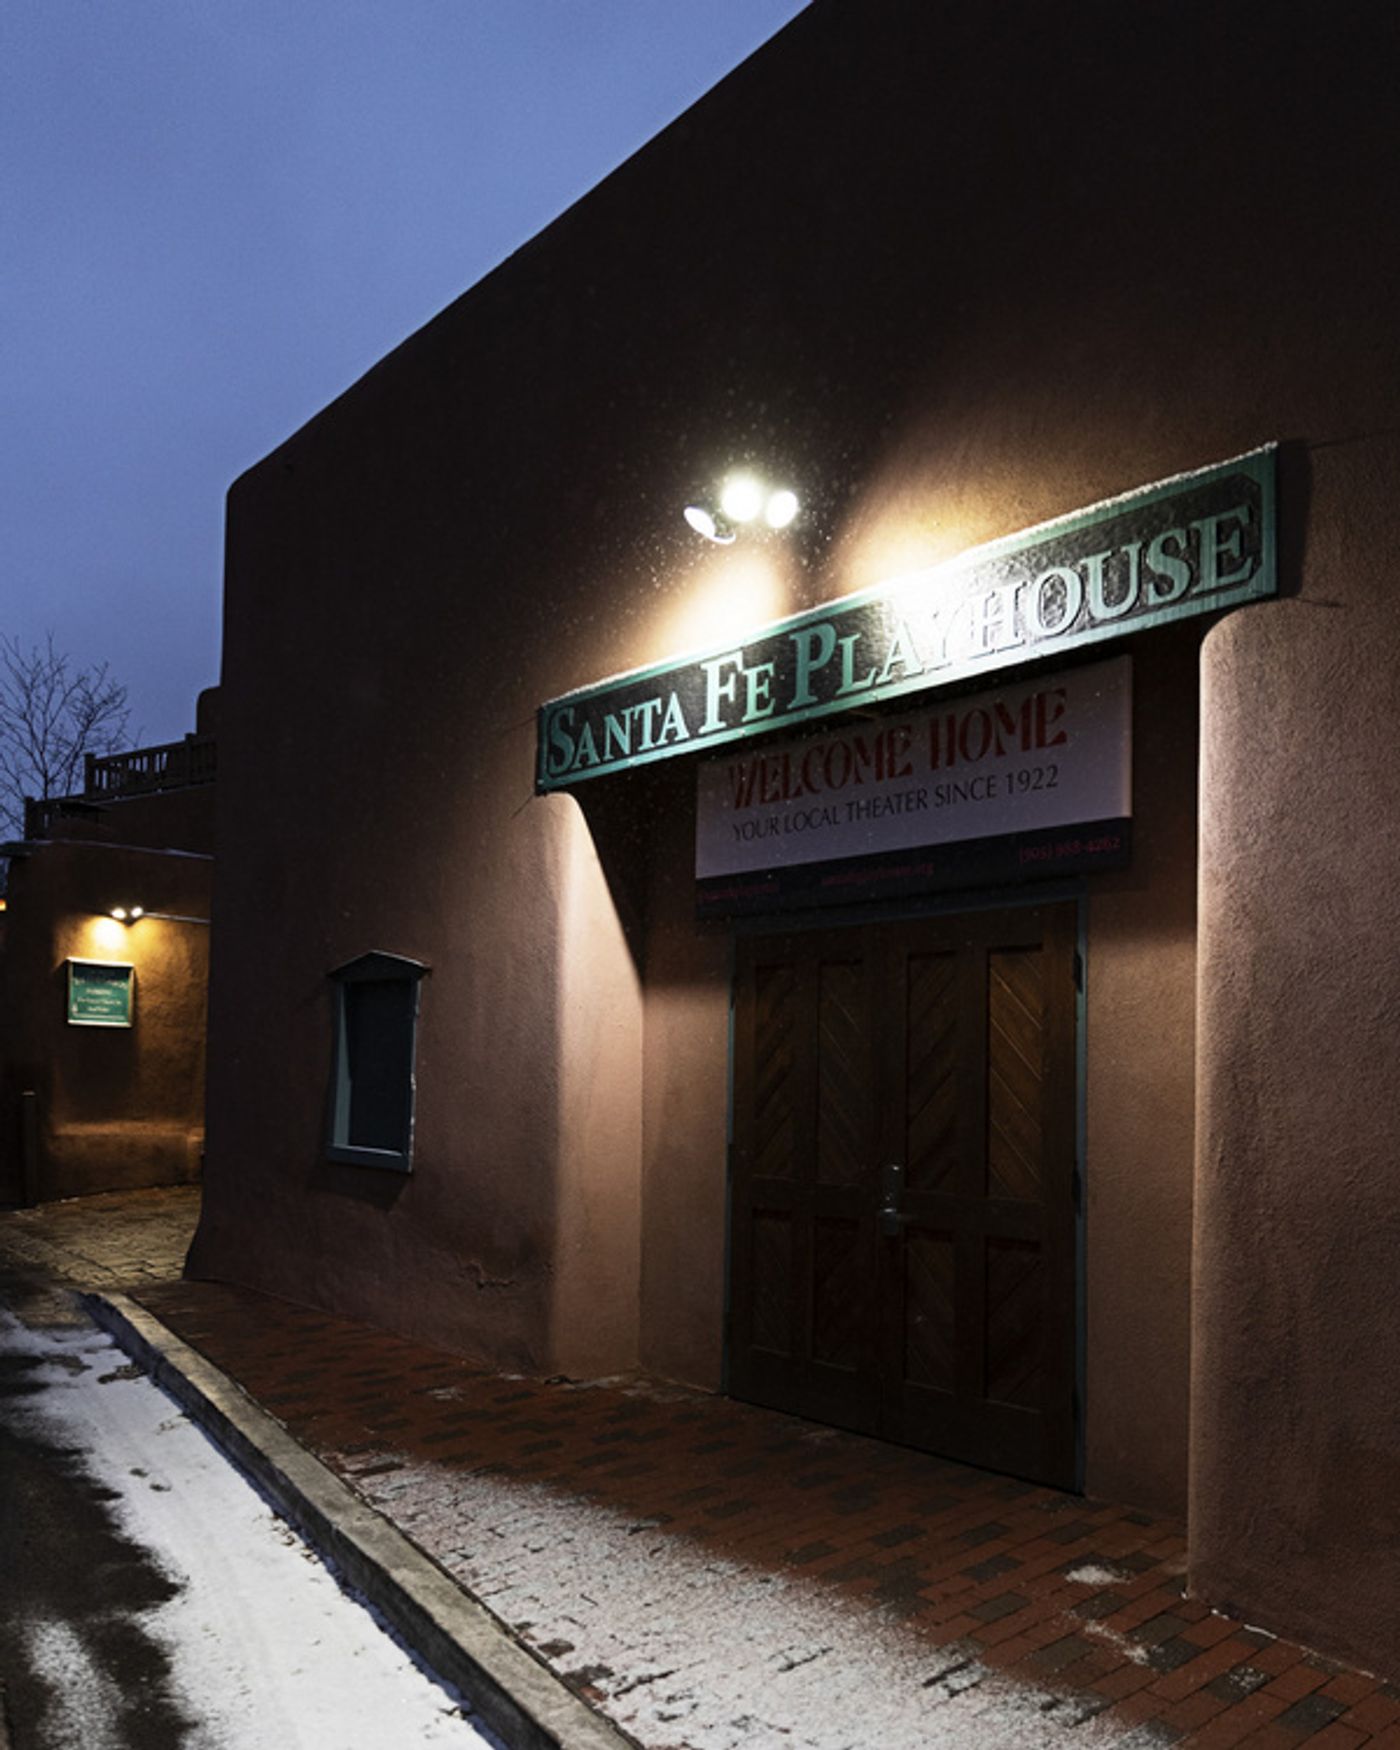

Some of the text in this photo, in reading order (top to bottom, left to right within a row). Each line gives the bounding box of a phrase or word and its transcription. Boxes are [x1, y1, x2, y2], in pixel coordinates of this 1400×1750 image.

[550, 505, 1255, 775] SANTA FE PLAYHOUSE
[729, 688, 1067, 810] WELCOME HOME
[732, 763, 1059, 841] YOUR LOCAL THEATER SINCE 1922
